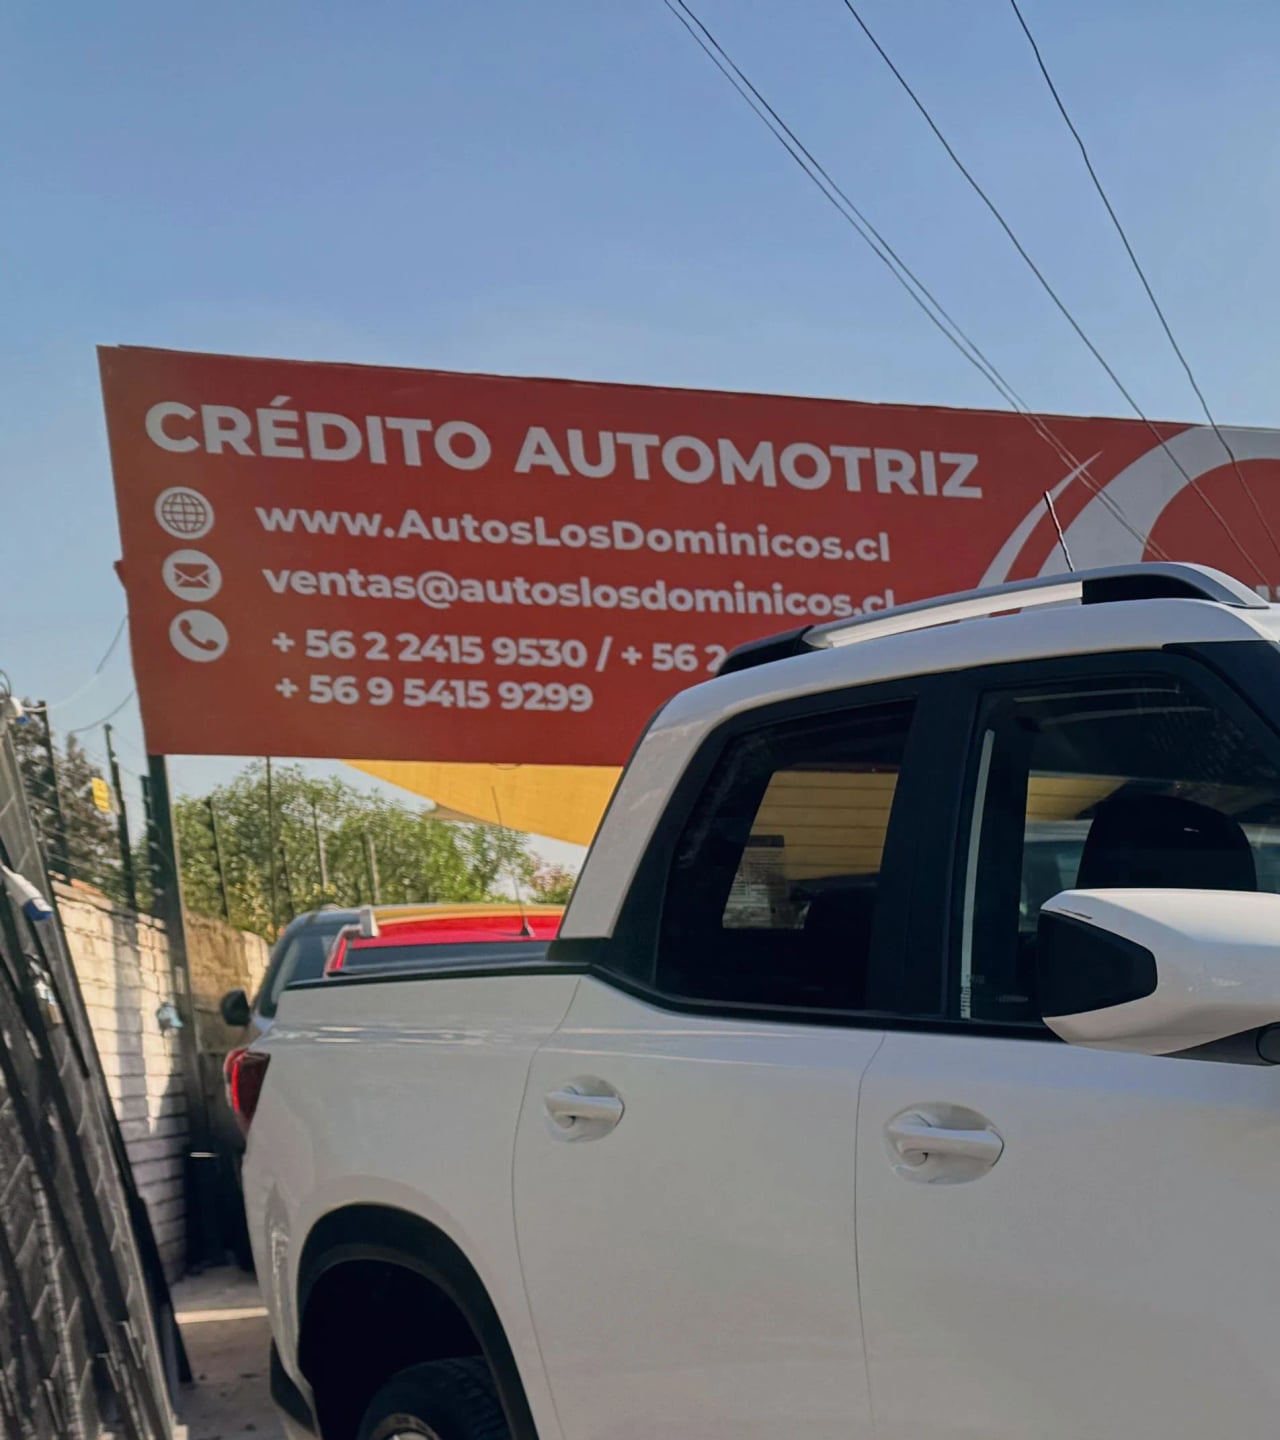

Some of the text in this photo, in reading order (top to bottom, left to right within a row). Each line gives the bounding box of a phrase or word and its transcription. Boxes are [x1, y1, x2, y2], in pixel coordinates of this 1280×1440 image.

[144, 395, 983, 499] CRÉDITO AUTOMOTRIZ
[254, 505, 891, 562] www.AutosLosDominicos.cl
[305, 628, 356, 660] 56
[362, 631, 390, 661] 2
[396, 633, 486, 666] 2415
[491, 636, 588, 669] 9530
[651, 642, 699, 672] 56
[308, 674, 359, 705] 56
[366, 676, 393, 706] 9
[402, 678, 491, 710] 5415
[498, 681, 594, 713] 9299
